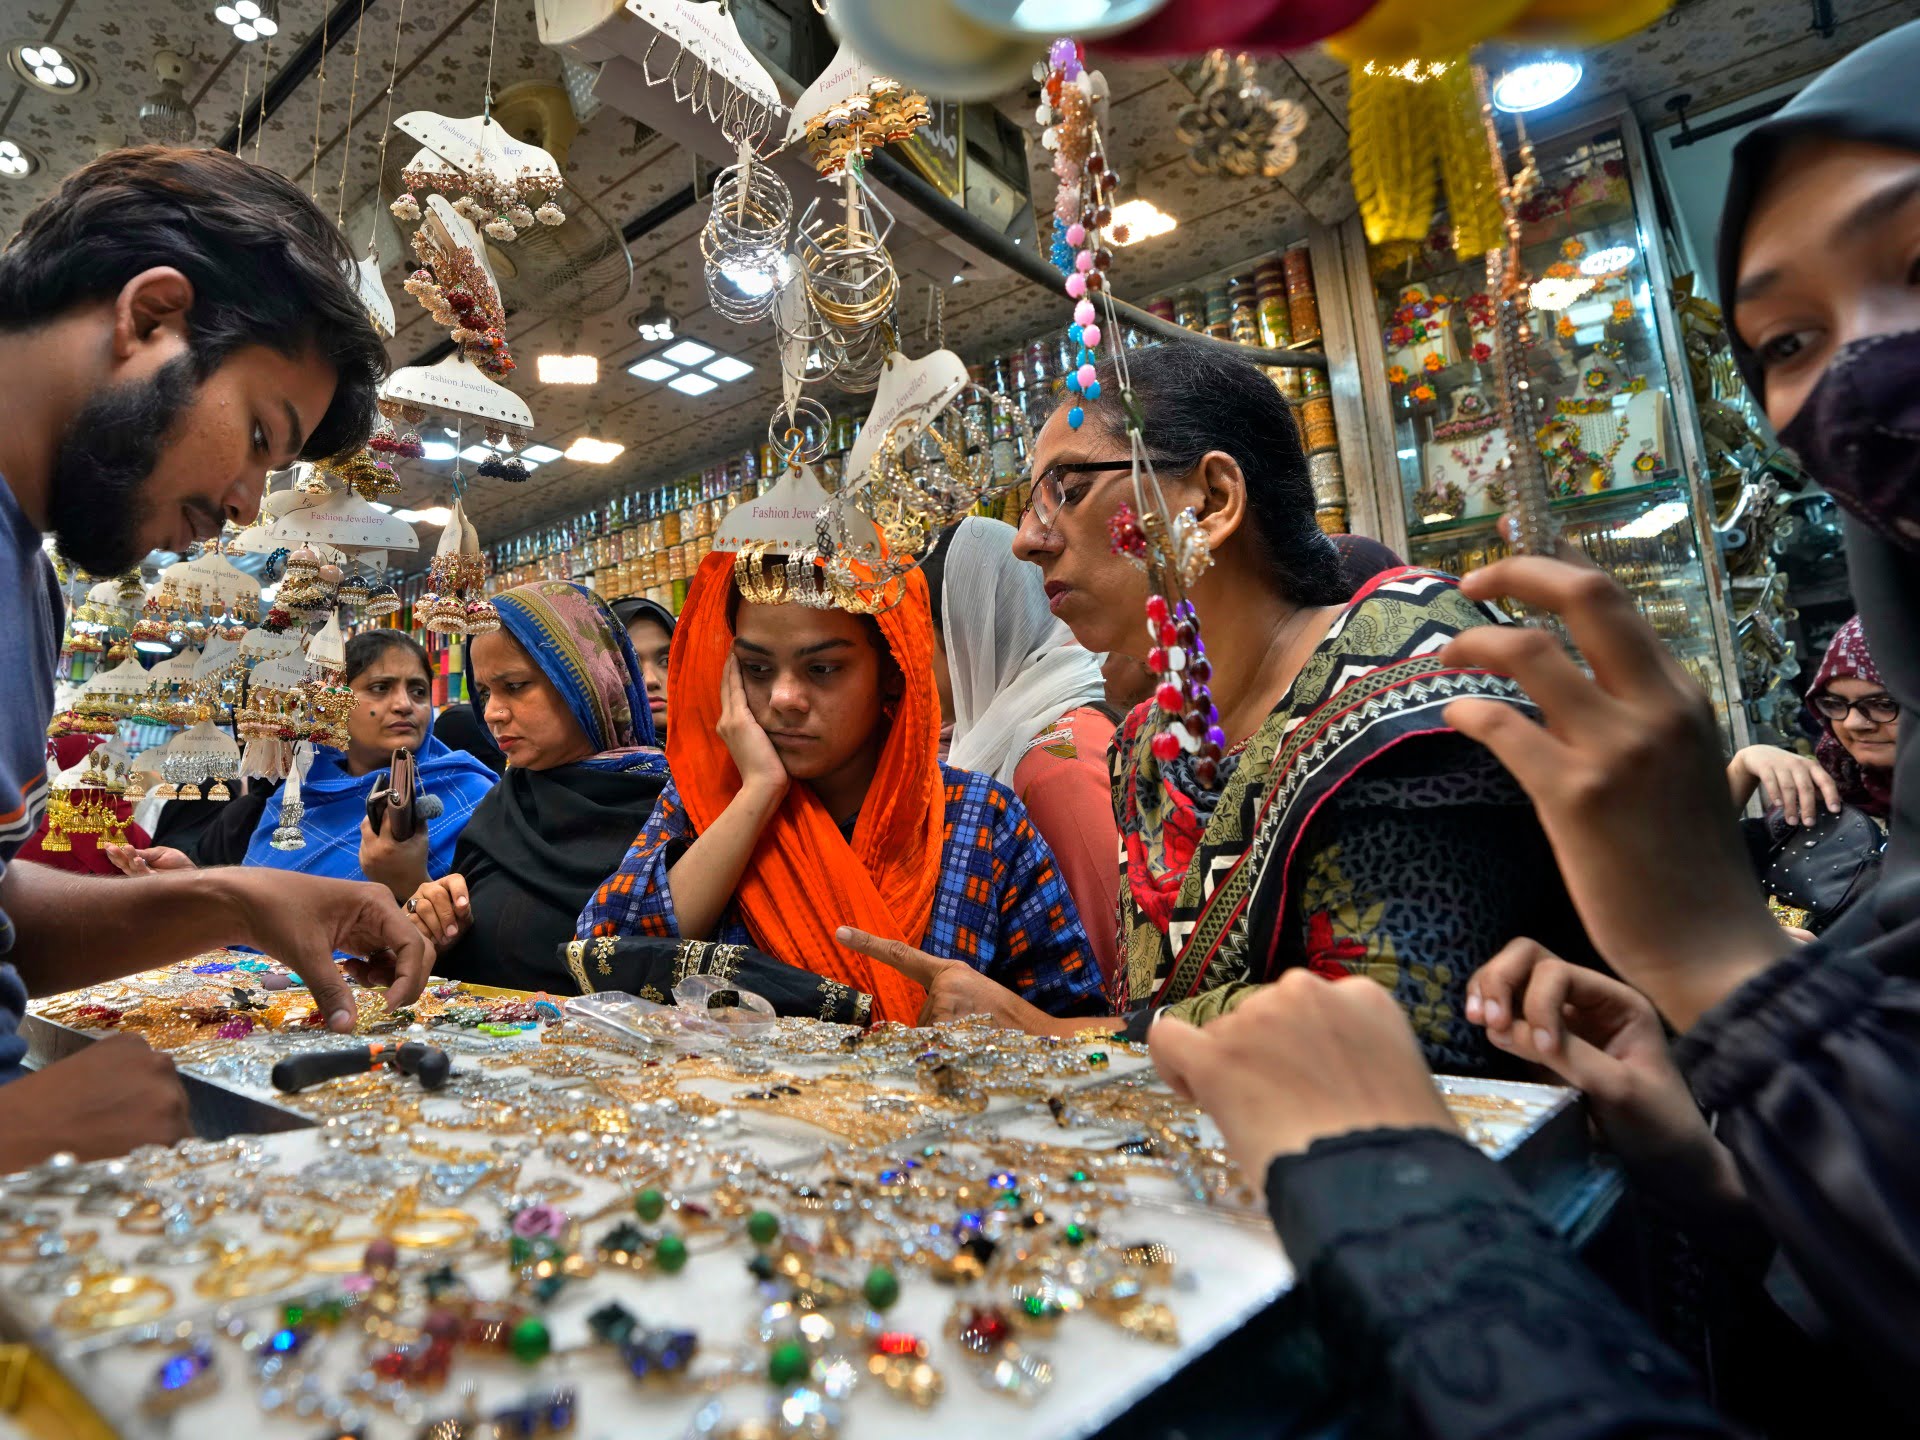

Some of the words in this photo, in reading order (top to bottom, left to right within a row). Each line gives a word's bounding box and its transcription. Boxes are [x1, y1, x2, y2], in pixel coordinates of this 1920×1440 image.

[675, 3, 710, 37] Fashion
[711, 32, 752, 68] Jewellery
[438, 119, 466, 142] Fashion
[465, 138, 498, 161] Jewllery
[424, 371, 459, 387] Fashion
[459, 380, 500, 396] Jewellery
[867, 406, 896, 438] Fashion
[896, 372, 928, 411] Jewellery
[311, 511, 343, 522] Fashion
[345, 514, 385, 525] Jewellery
[752, 506, 789, 519] Fashion
[791, 506, 837, 522] Jewery
[187, 564, 211, 575] Fashion
[277, 663, 301, 675] Fashion
